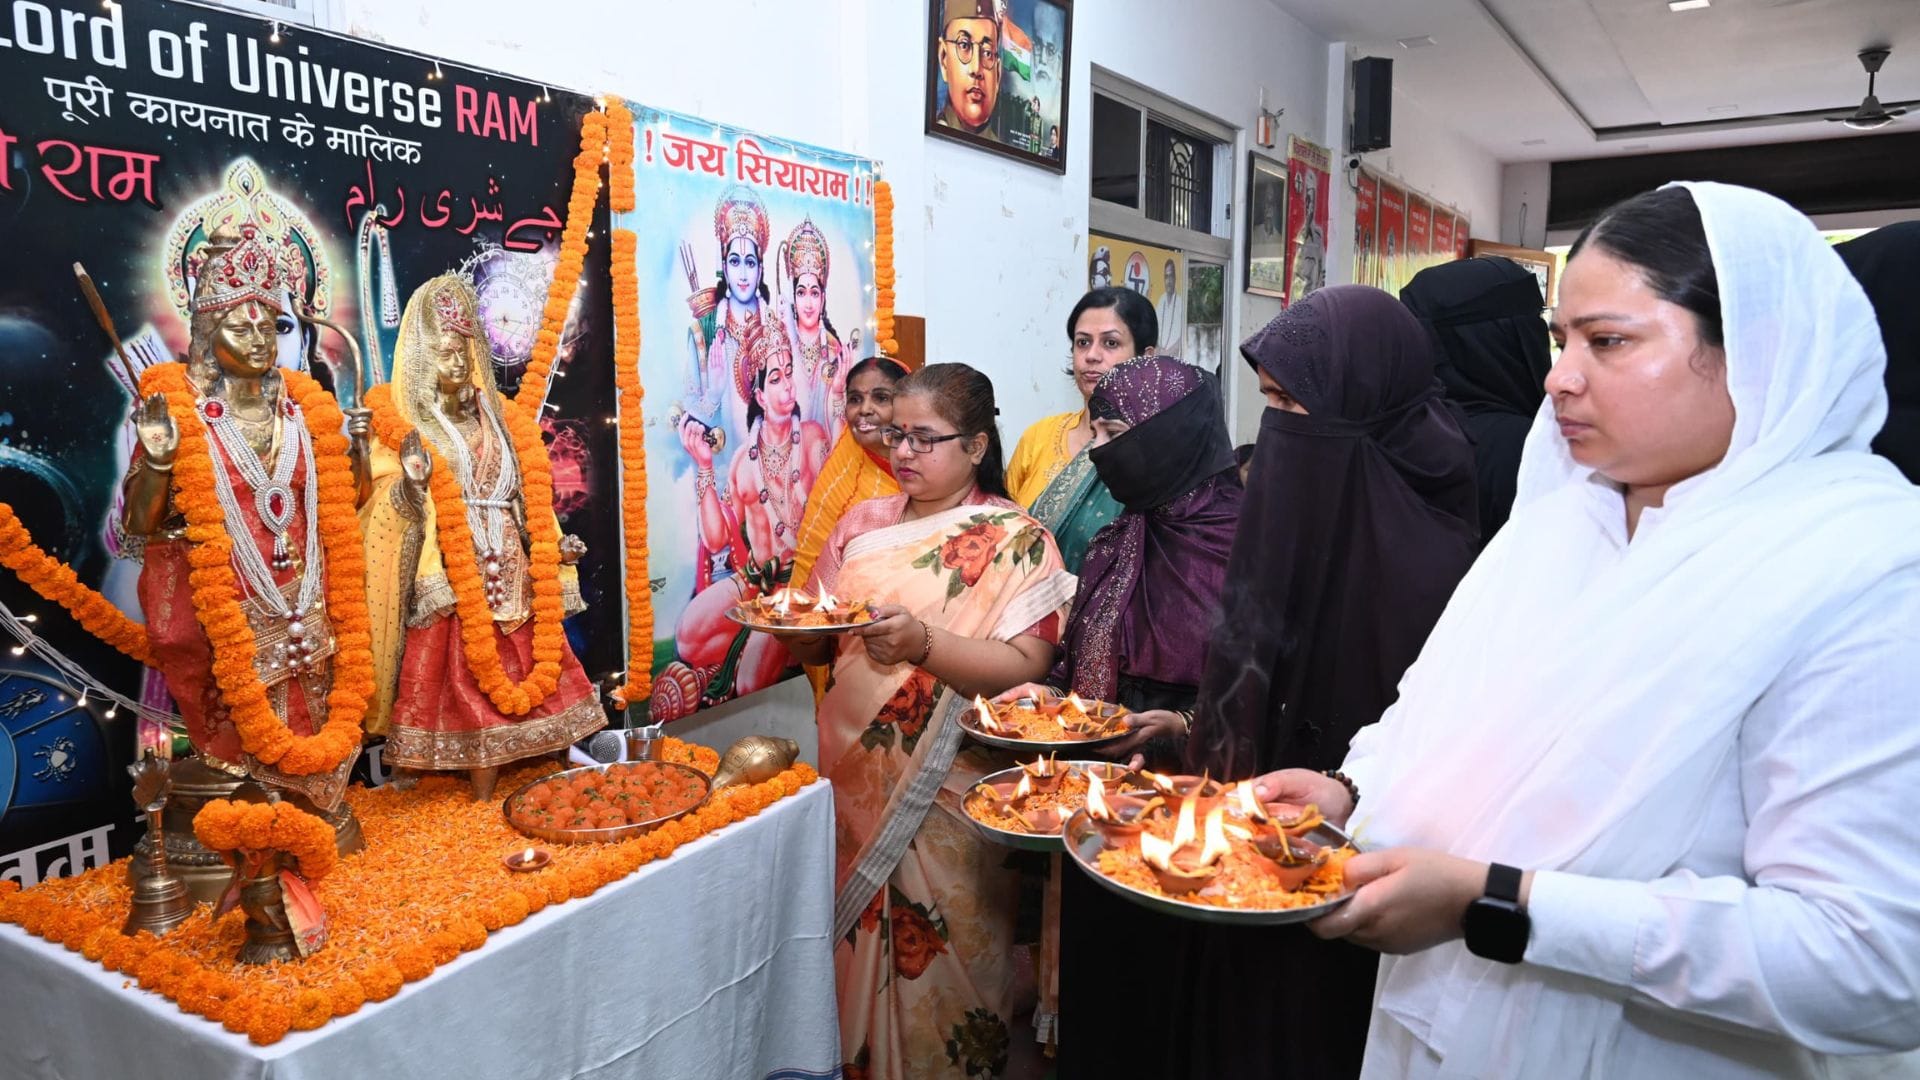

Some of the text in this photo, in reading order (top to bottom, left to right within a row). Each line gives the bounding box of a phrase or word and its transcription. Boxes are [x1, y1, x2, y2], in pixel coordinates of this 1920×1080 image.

[0, 0, 539, 147] ord of Universe RAM
[43, 75, 422, 165] पूरी कायनात के मालिक
[36, 140, 161, 205] राम
[345, 158, 405, 230] رام
[662, 134, 729, 177] जय
[736, 138, 850, 201] सियाराम
